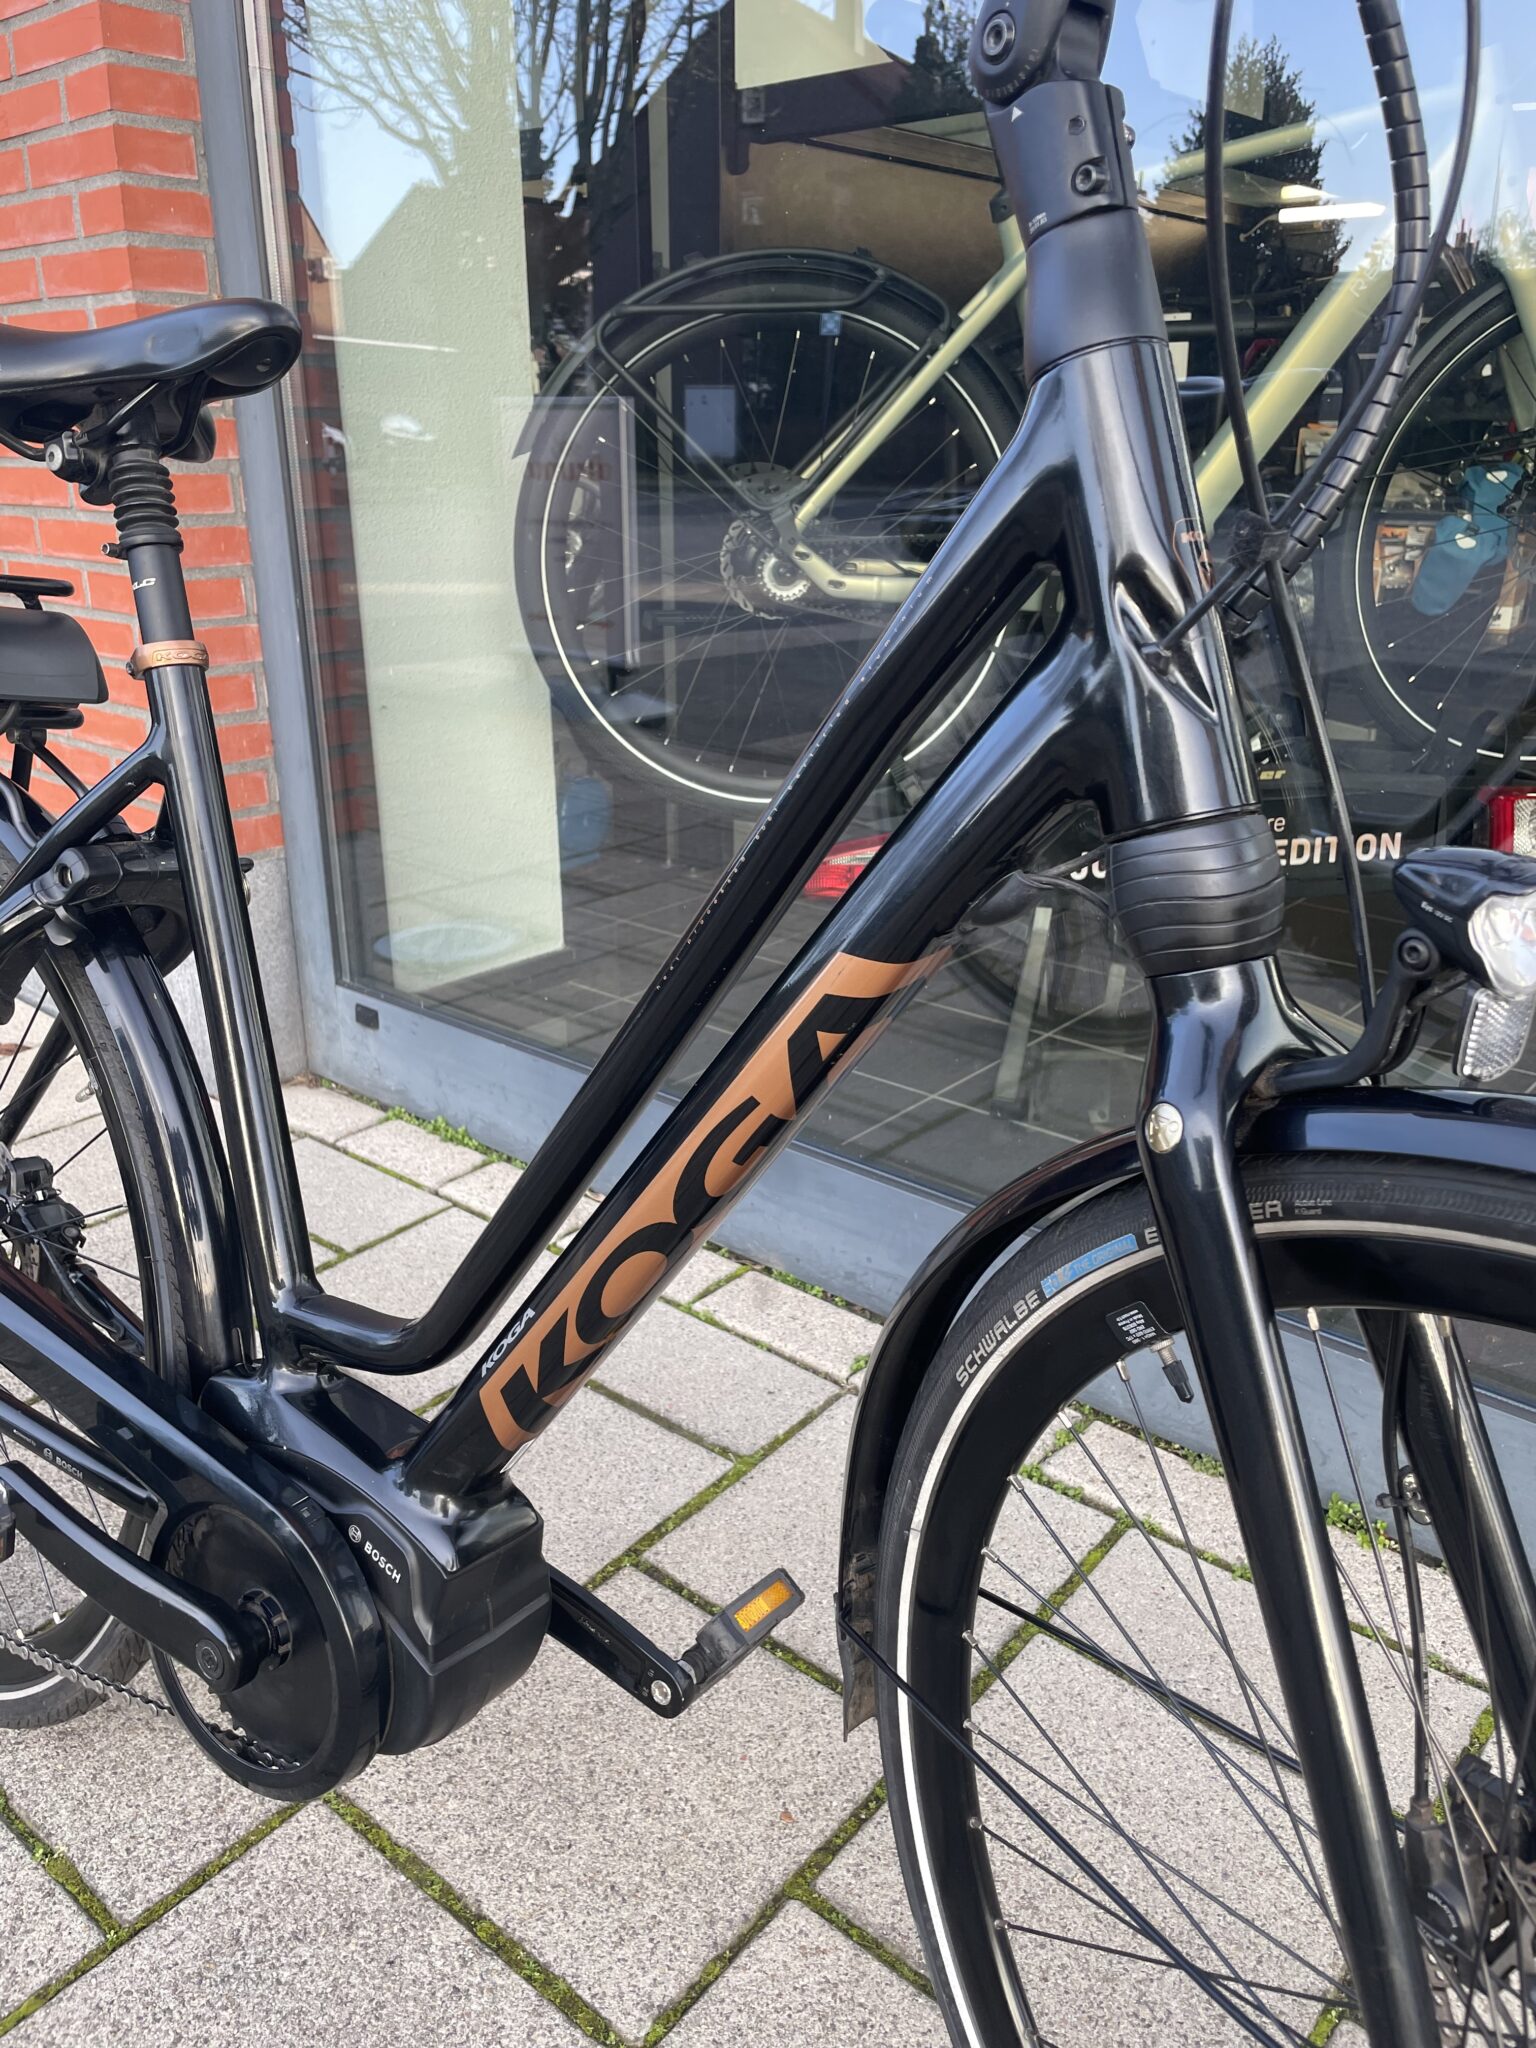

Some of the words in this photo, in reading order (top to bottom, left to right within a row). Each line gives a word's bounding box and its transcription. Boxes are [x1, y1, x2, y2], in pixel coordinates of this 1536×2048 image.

[1267, 816, 1286, 833] re
[1275, 831, 1402, 866] EDITON
[499, 992, 895, 1434] KOGA
[481, 1306, 536, 1379] KOGA
[954, 1288, 1042, 1389] SCHWALBE
[55, 1456, 84, 1480] BOSCH
[363, 1540, 402, 1584] BOSCH
